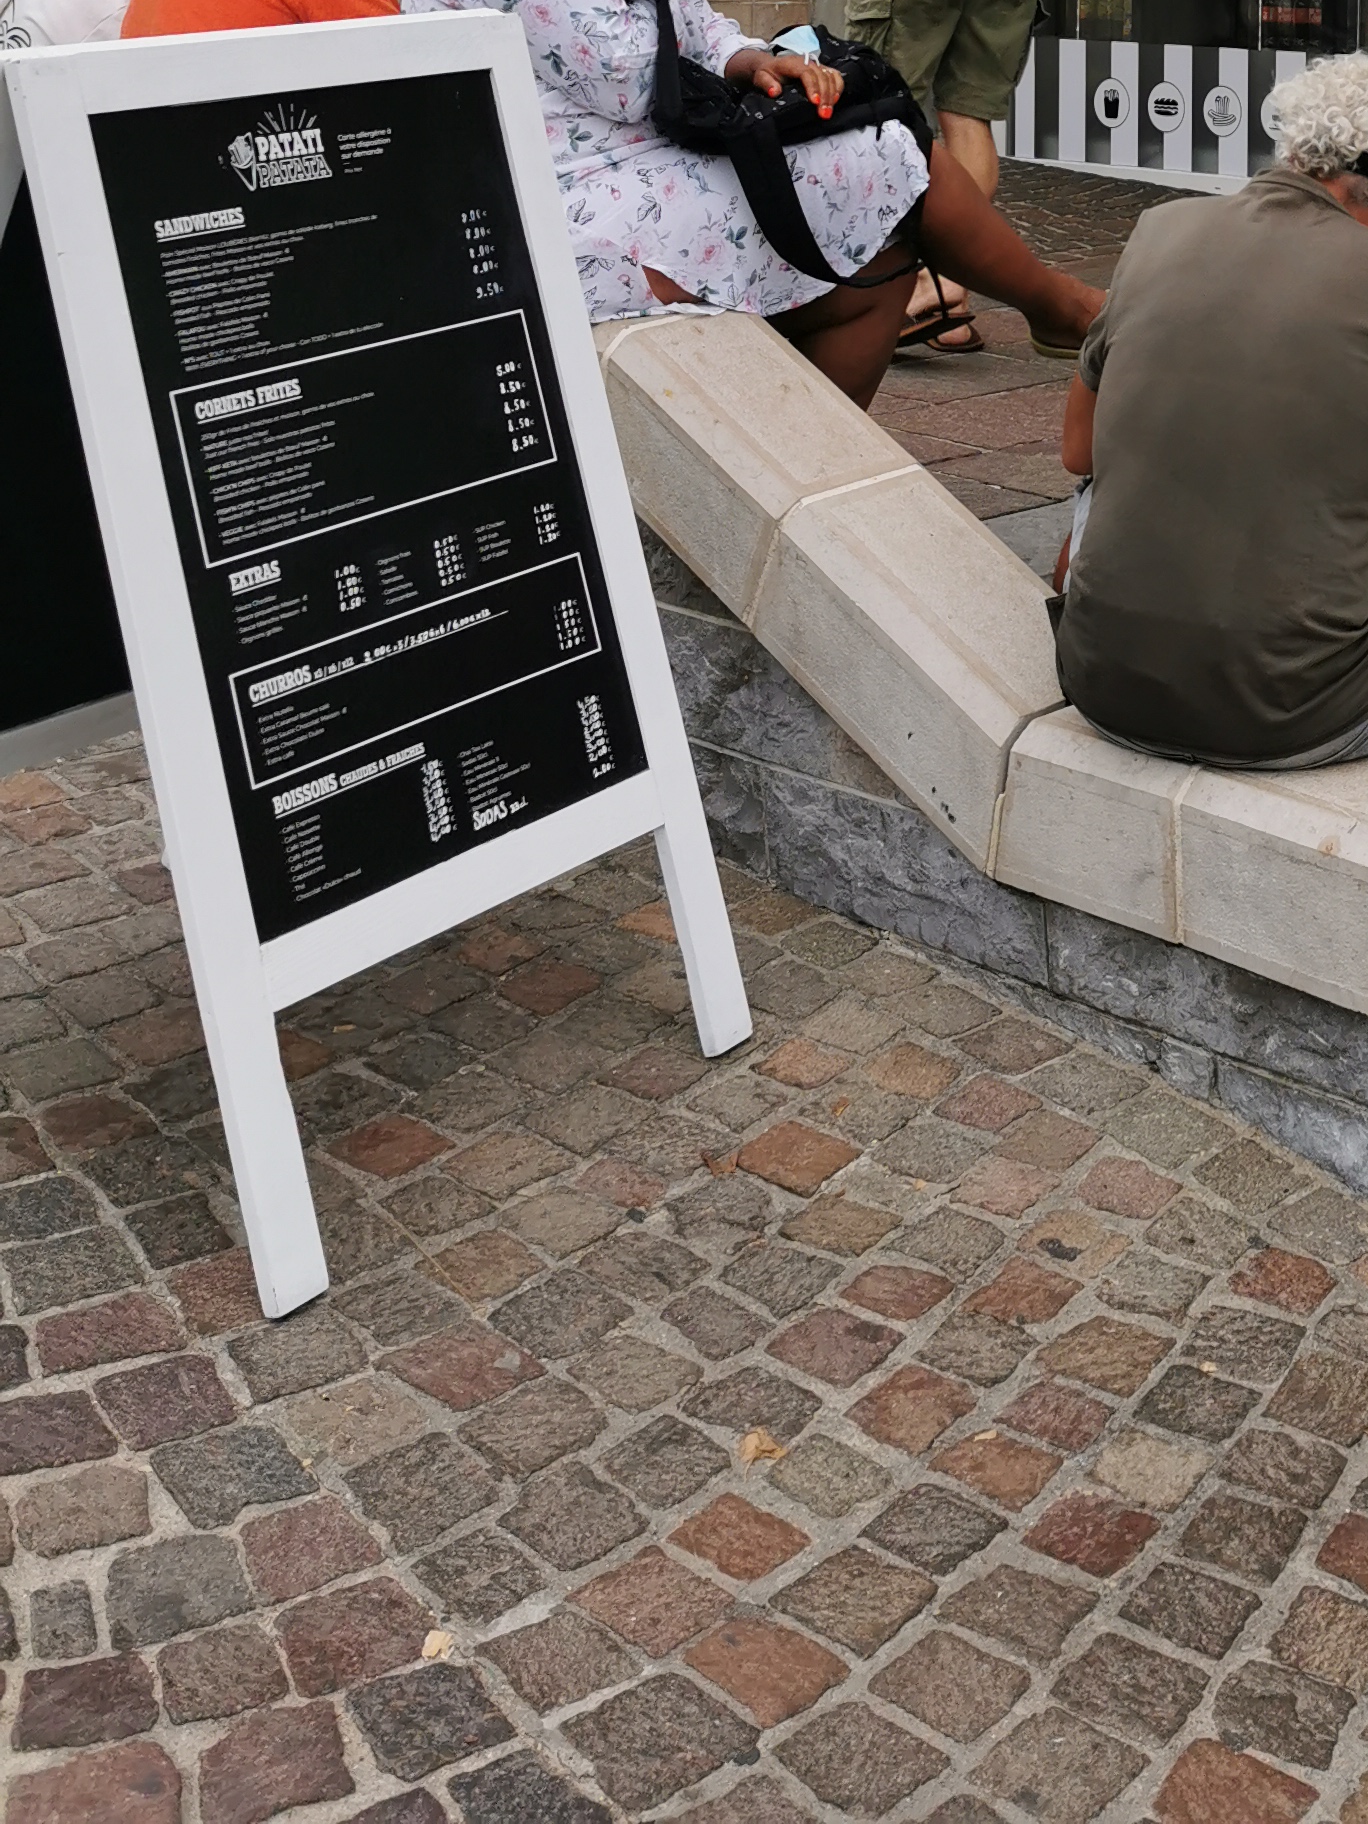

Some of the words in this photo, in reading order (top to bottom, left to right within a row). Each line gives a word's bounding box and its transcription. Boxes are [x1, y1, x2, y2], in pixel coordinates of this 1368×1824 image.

[254, 128, 324, 161] PATATI
[337, 133, 355, 141] Carte
[352, 147, 383, 157] demande
[356, 138, 391, 148] disposition
[254, 154, 332, 188] PATATA
[154, 207, 244, 238] SANDWICHES
[194, 389, 256, 419] CORNETS
[255, 378, 301, 404] FRITES
[228, 560, 280, 591] EXTRAS
[249, 664, 312, 702] CHURROS
[271, 772, 338, 814] BOISSONS
[339, 761, 378, 786] CHAUDES
[472, 800, 508, 830] SODAS
